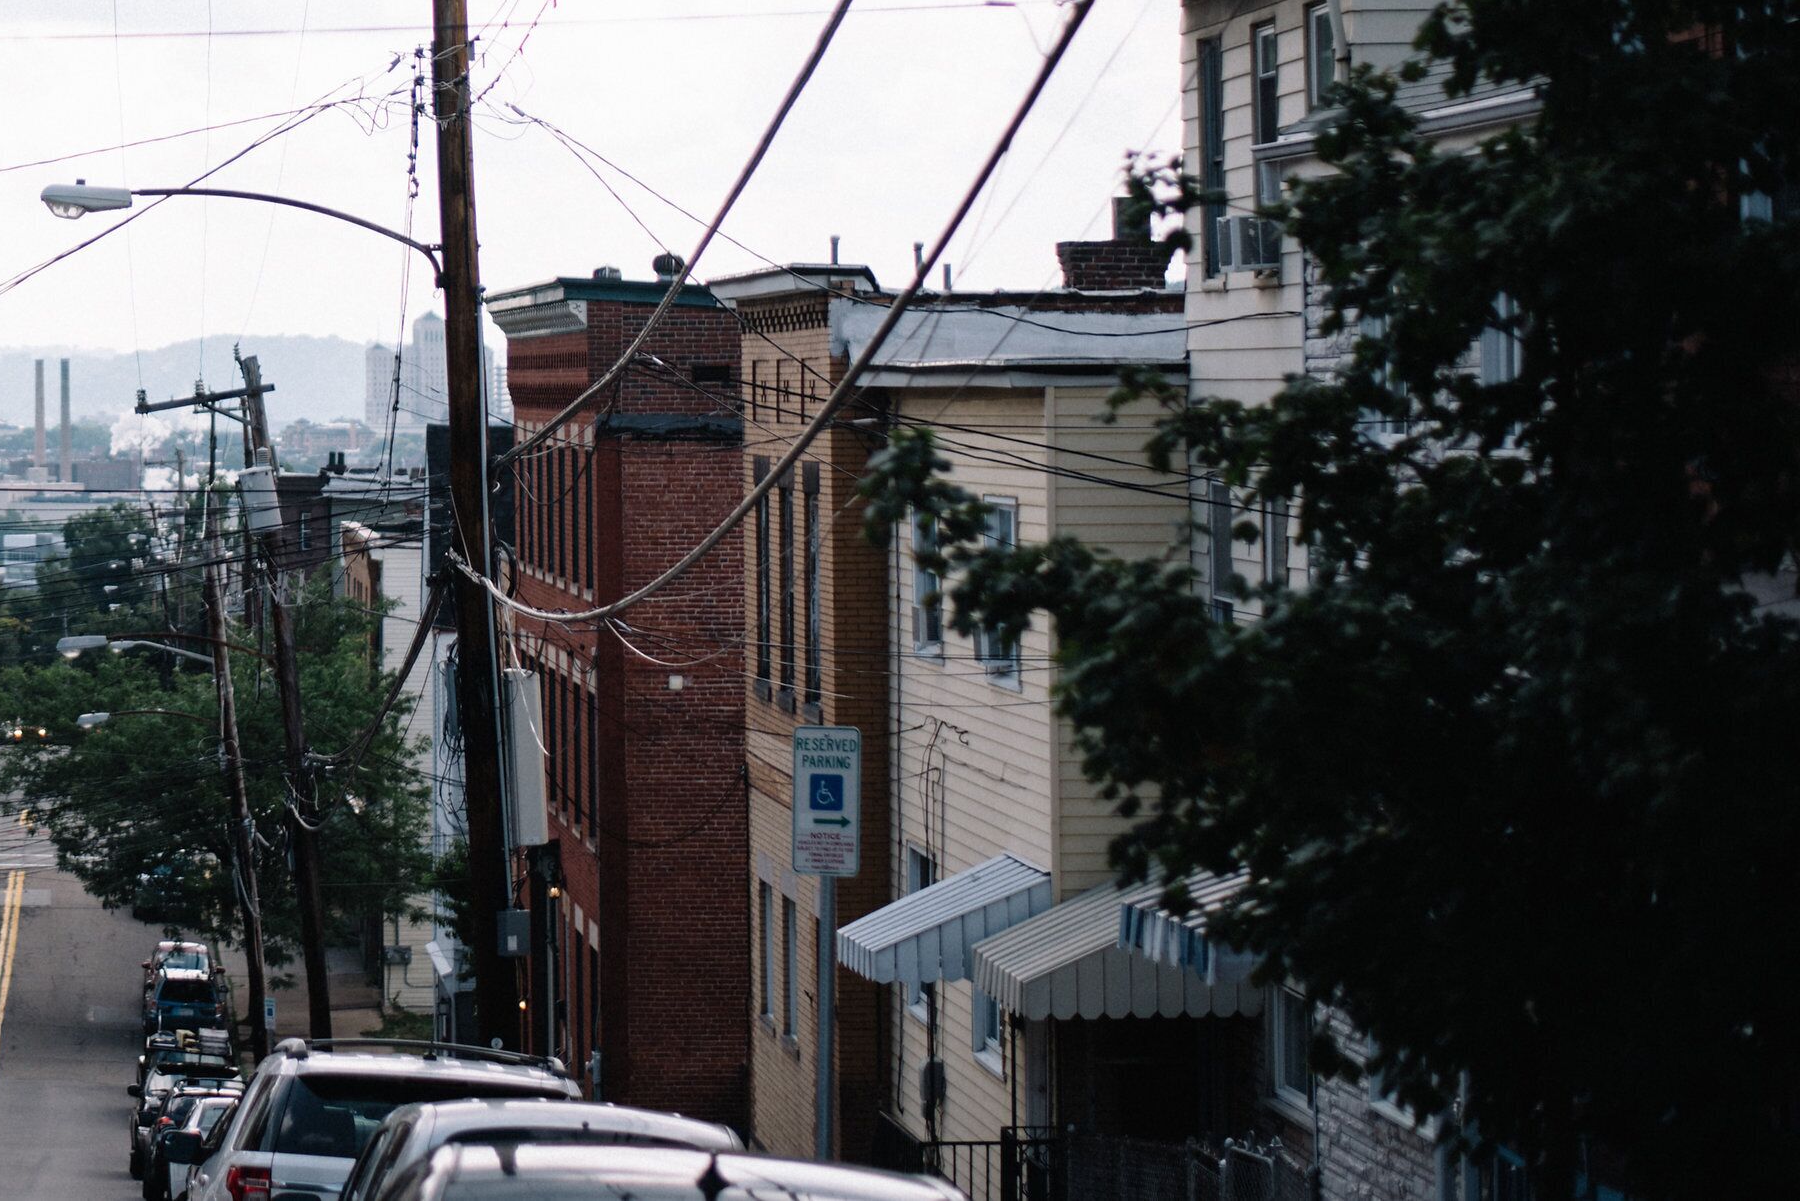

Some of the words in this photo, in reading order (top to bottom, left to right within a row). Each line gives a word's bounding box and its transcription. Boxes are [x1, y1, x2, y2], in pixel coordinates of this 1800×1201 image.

[796, 736, 857, 752] RESERVED
[802, 755, 851, 769] PARKING
[810, 832, 842, 840] NOTICE
